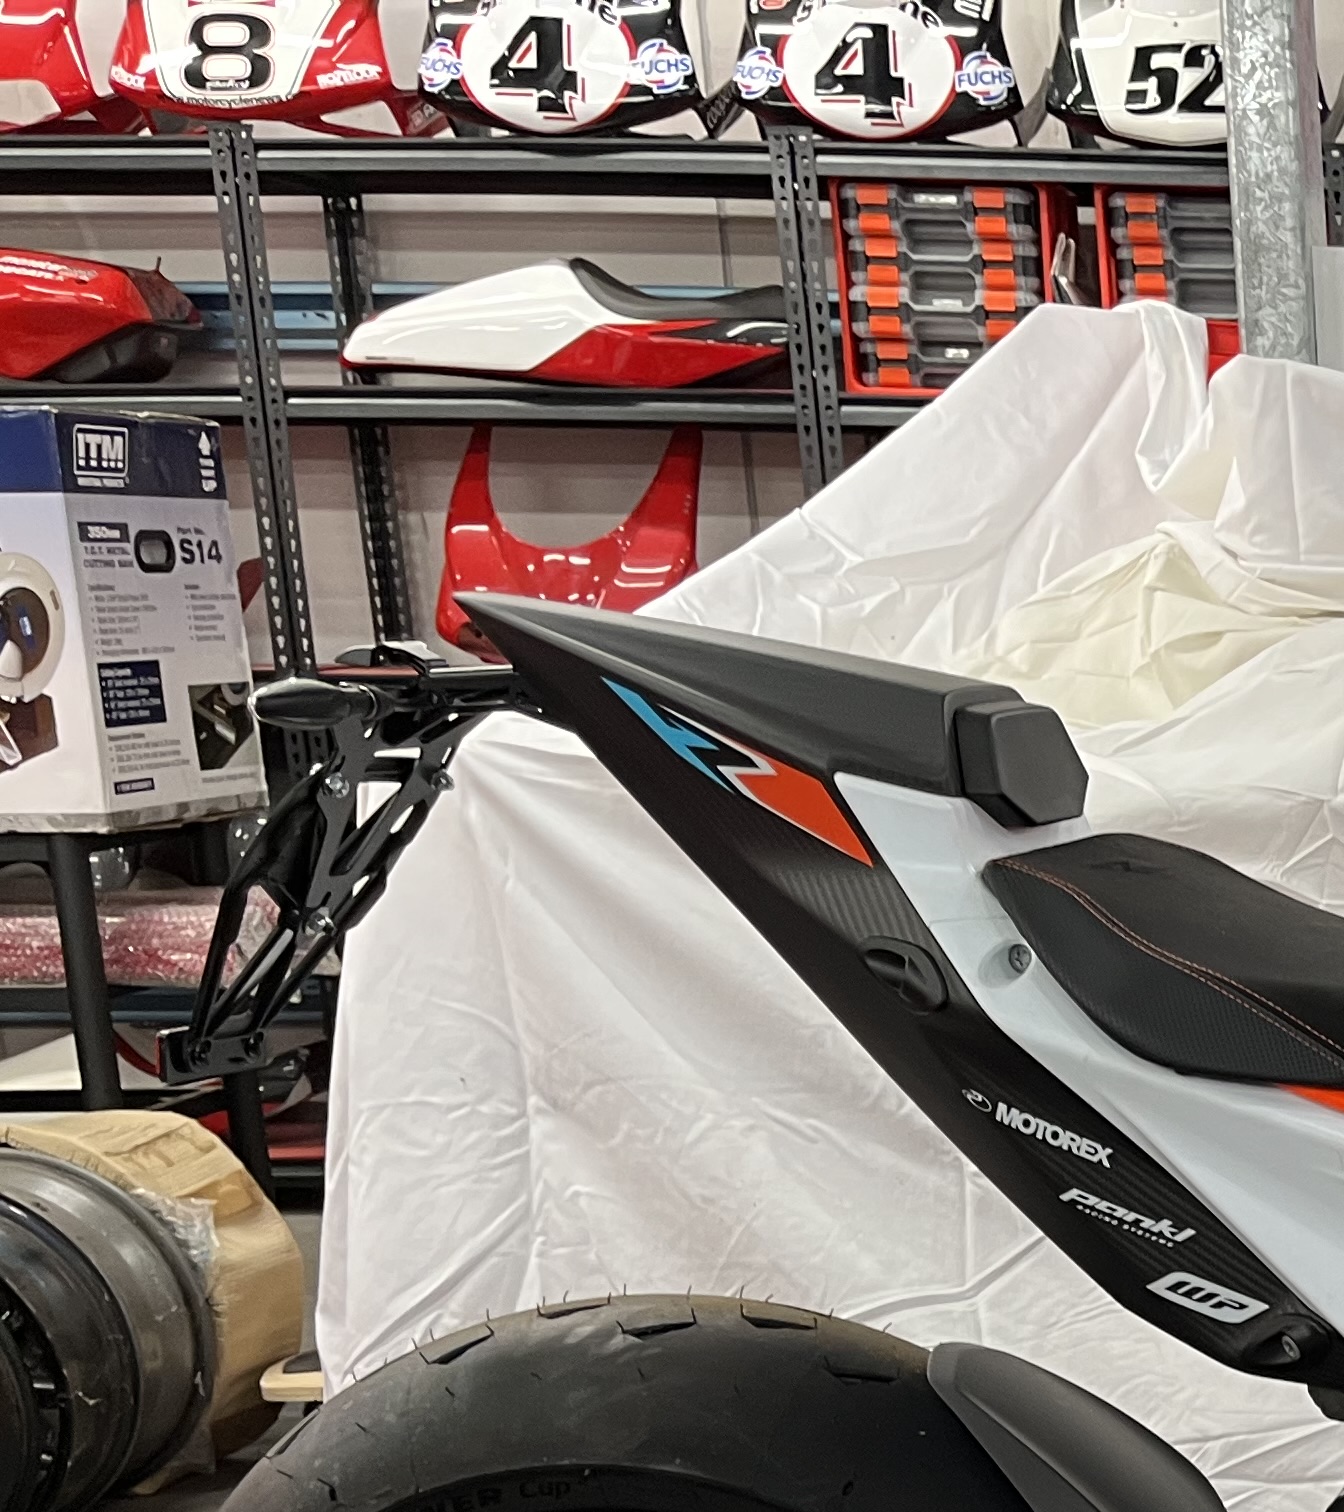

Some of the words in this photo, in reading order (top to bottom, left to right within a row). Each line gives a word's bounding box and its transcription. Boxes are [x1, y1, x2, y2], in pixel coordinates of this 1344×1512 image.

[184, 13, 272, 92] 8
[420, 55, 463, 76] FUCHS
[490, 15, 579, 114] 4
[736, 63, 782, 83] FUCHS
[814, 22, 906, 120] 4
[956, 70, 1014, 89] FUCHS
[77, 433, 124, 468] ITM
[179, 538, 222, 565] S14
[995, 1101, 1113, 1168] MOTOREX
